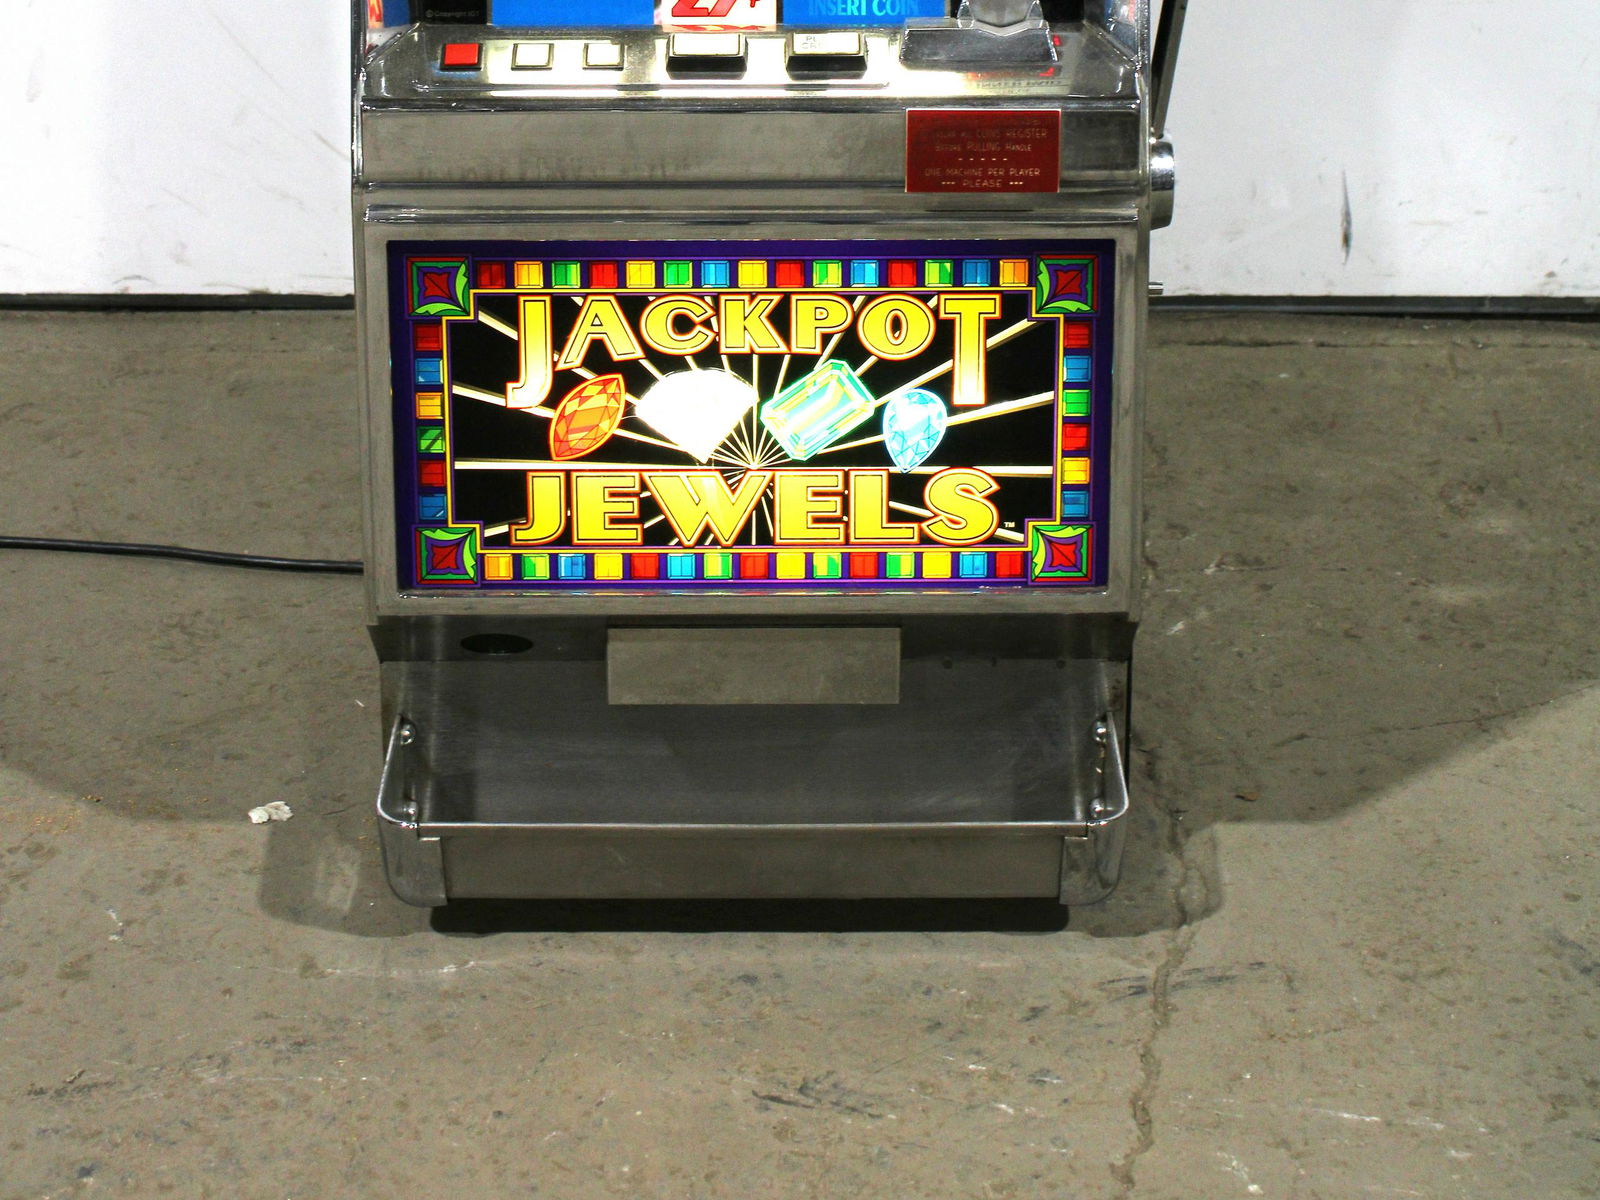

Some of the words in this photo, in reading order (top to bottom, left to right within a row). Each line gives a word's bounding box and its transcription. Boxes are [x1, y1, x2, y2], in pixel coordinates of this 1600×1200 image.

[988, 168, 1005, 177] PER
[1009, 168, 1041, 177] PLAYER
[506, 293, 1002, 409] JACKPOT
[509, 467, 1001, 548] JEWELS
